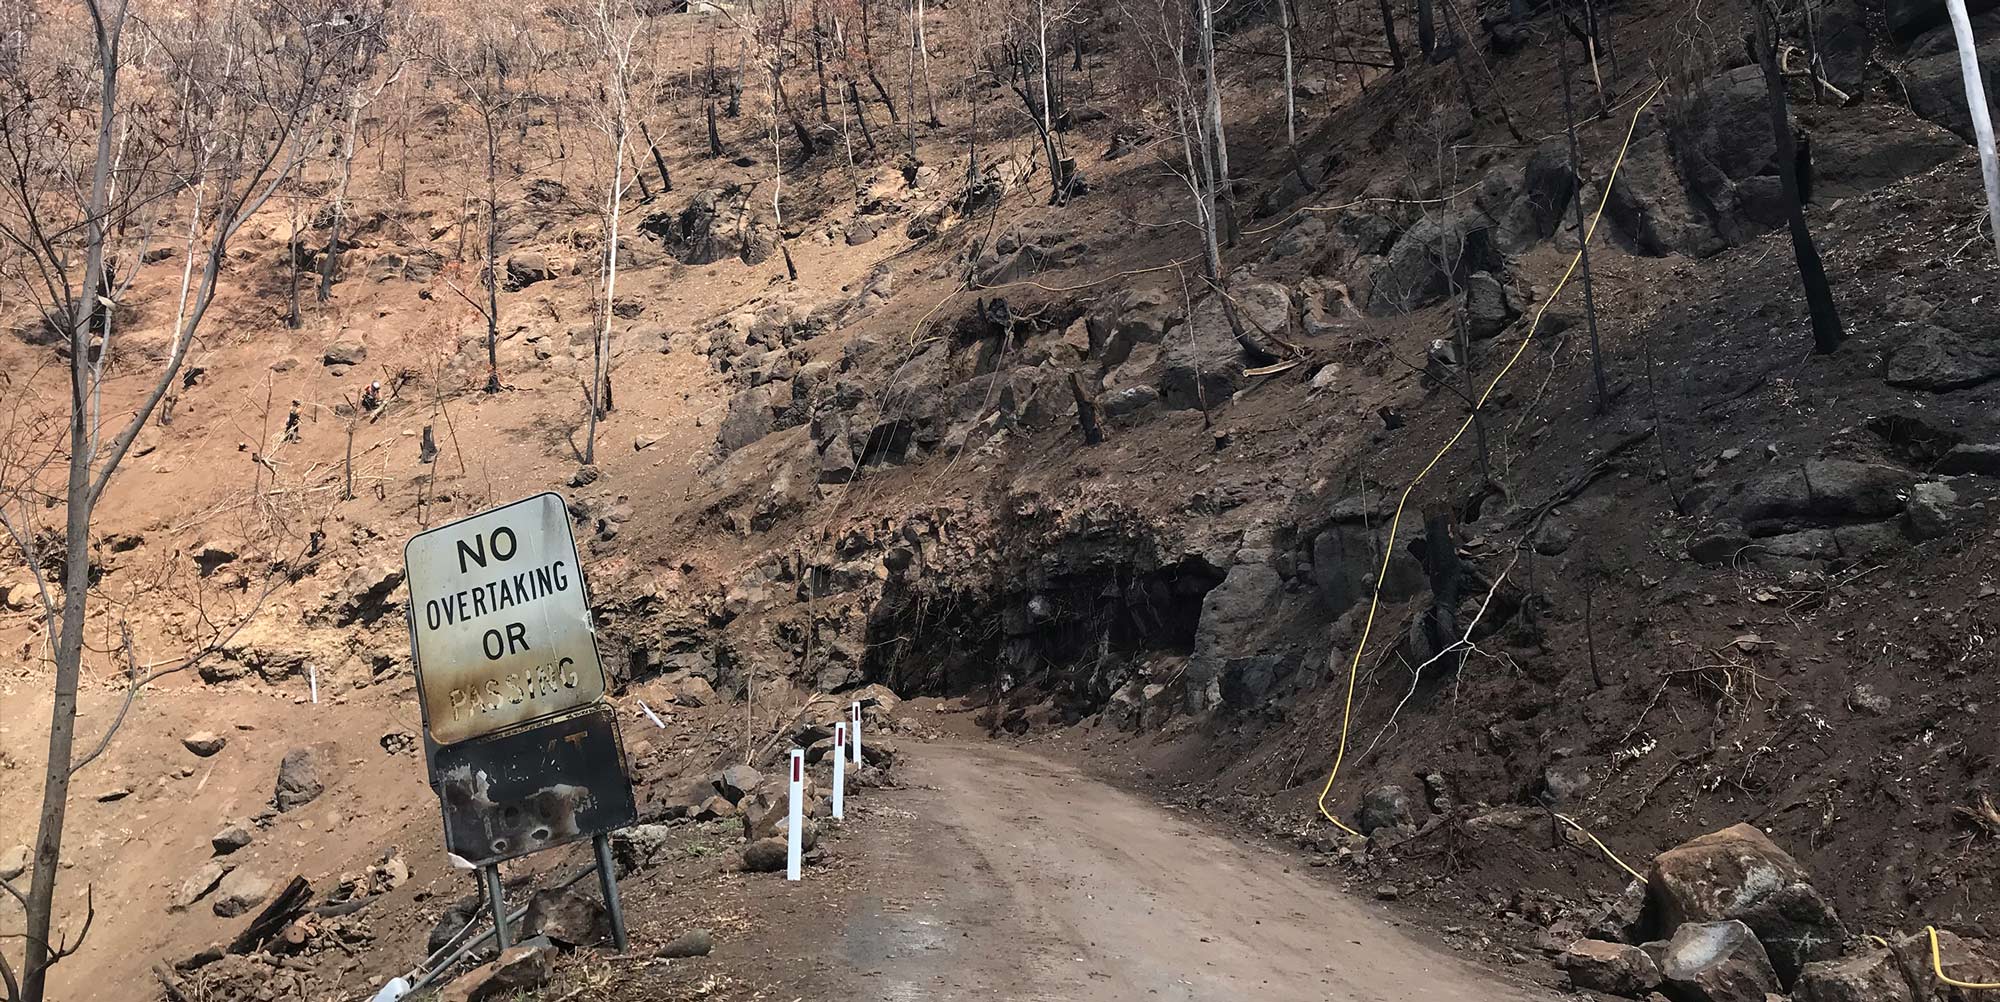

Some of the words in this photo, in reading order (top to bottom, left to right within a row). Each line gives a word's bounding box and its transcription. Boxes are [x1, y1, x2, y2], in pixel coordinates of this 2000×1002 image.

[456, 526, 517, 573] NO
[427, 560, 568, 631] OVERTAKING
[483, 622, 530, 661] OR
[450, 657, 579, 721] PASSING
